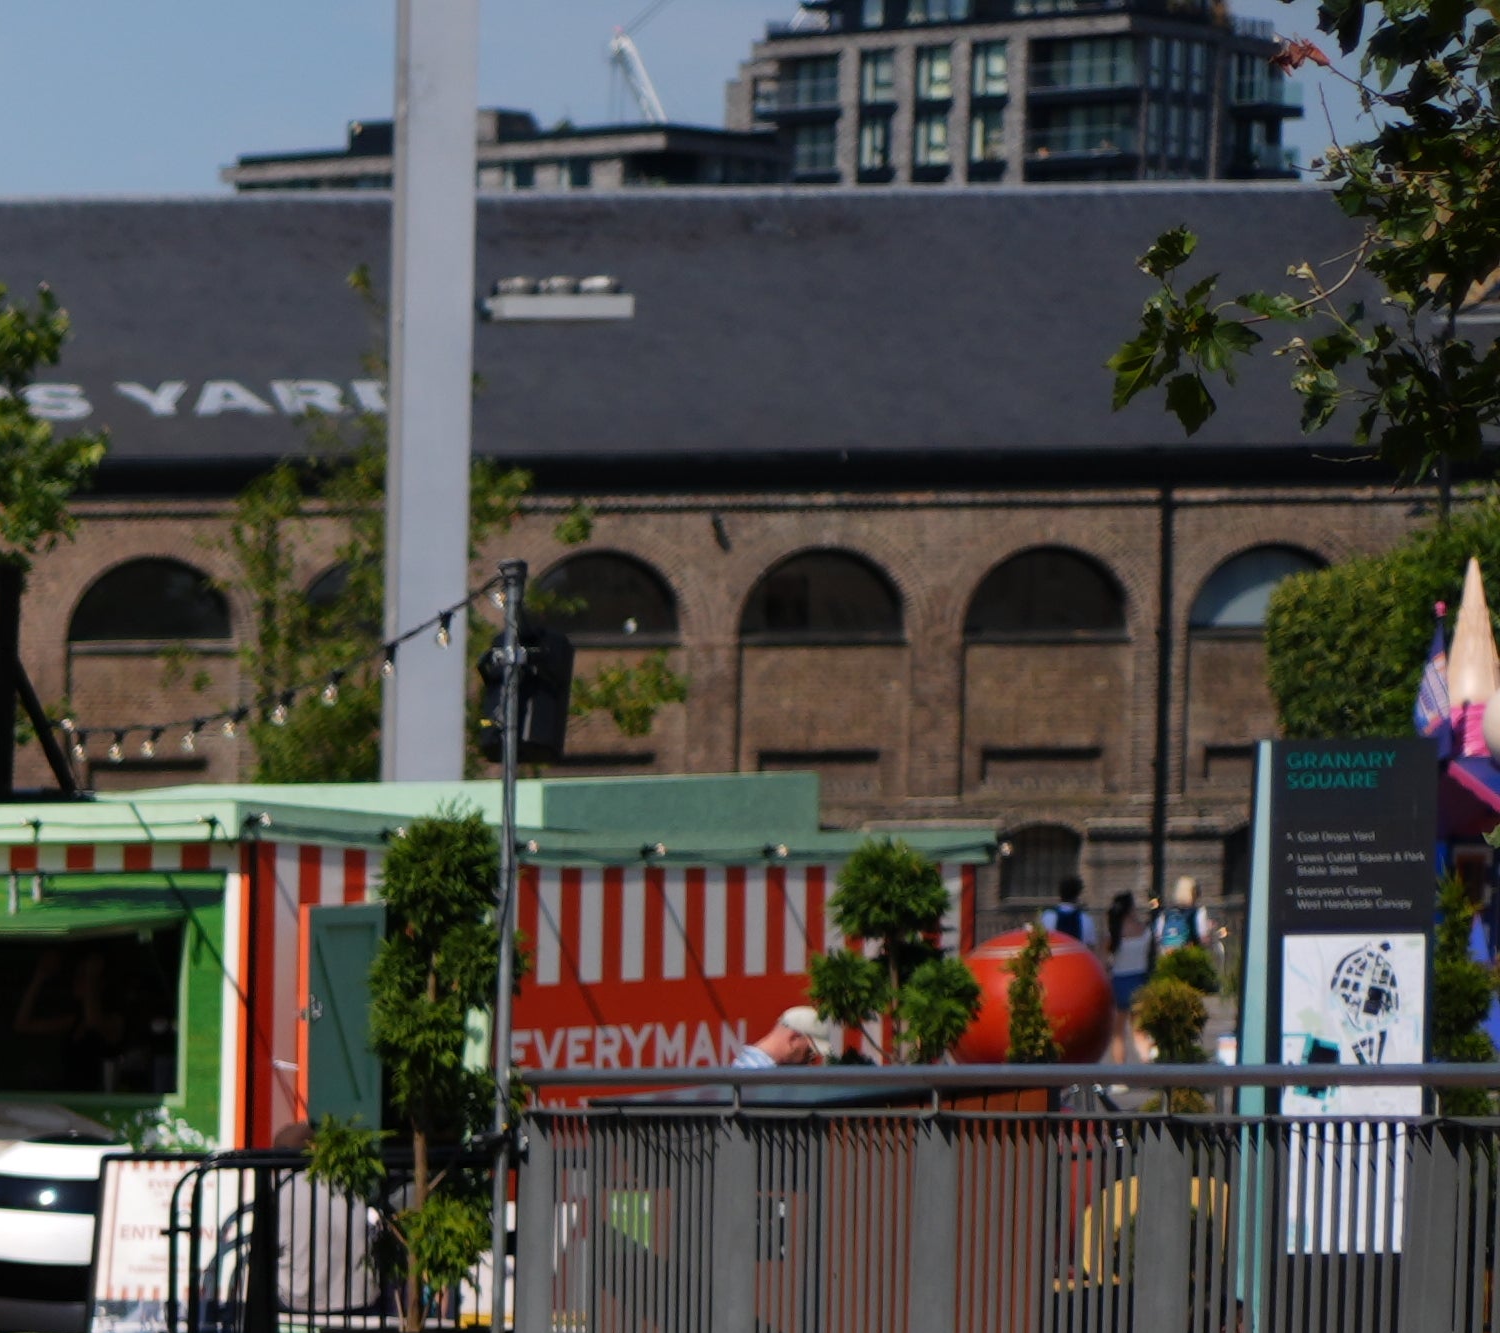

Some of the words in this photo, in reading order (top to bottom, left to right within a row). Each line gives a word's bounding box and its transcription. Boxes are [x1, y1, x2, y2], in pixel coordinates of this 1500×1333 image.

[1286, 752, 1396, 769] GRANARY
[1286, 770, 1379, 789] SQUARE
[1353, 831, 1376, 842] Yard
[508, 1019, 747, 1069] EVERYMAN
